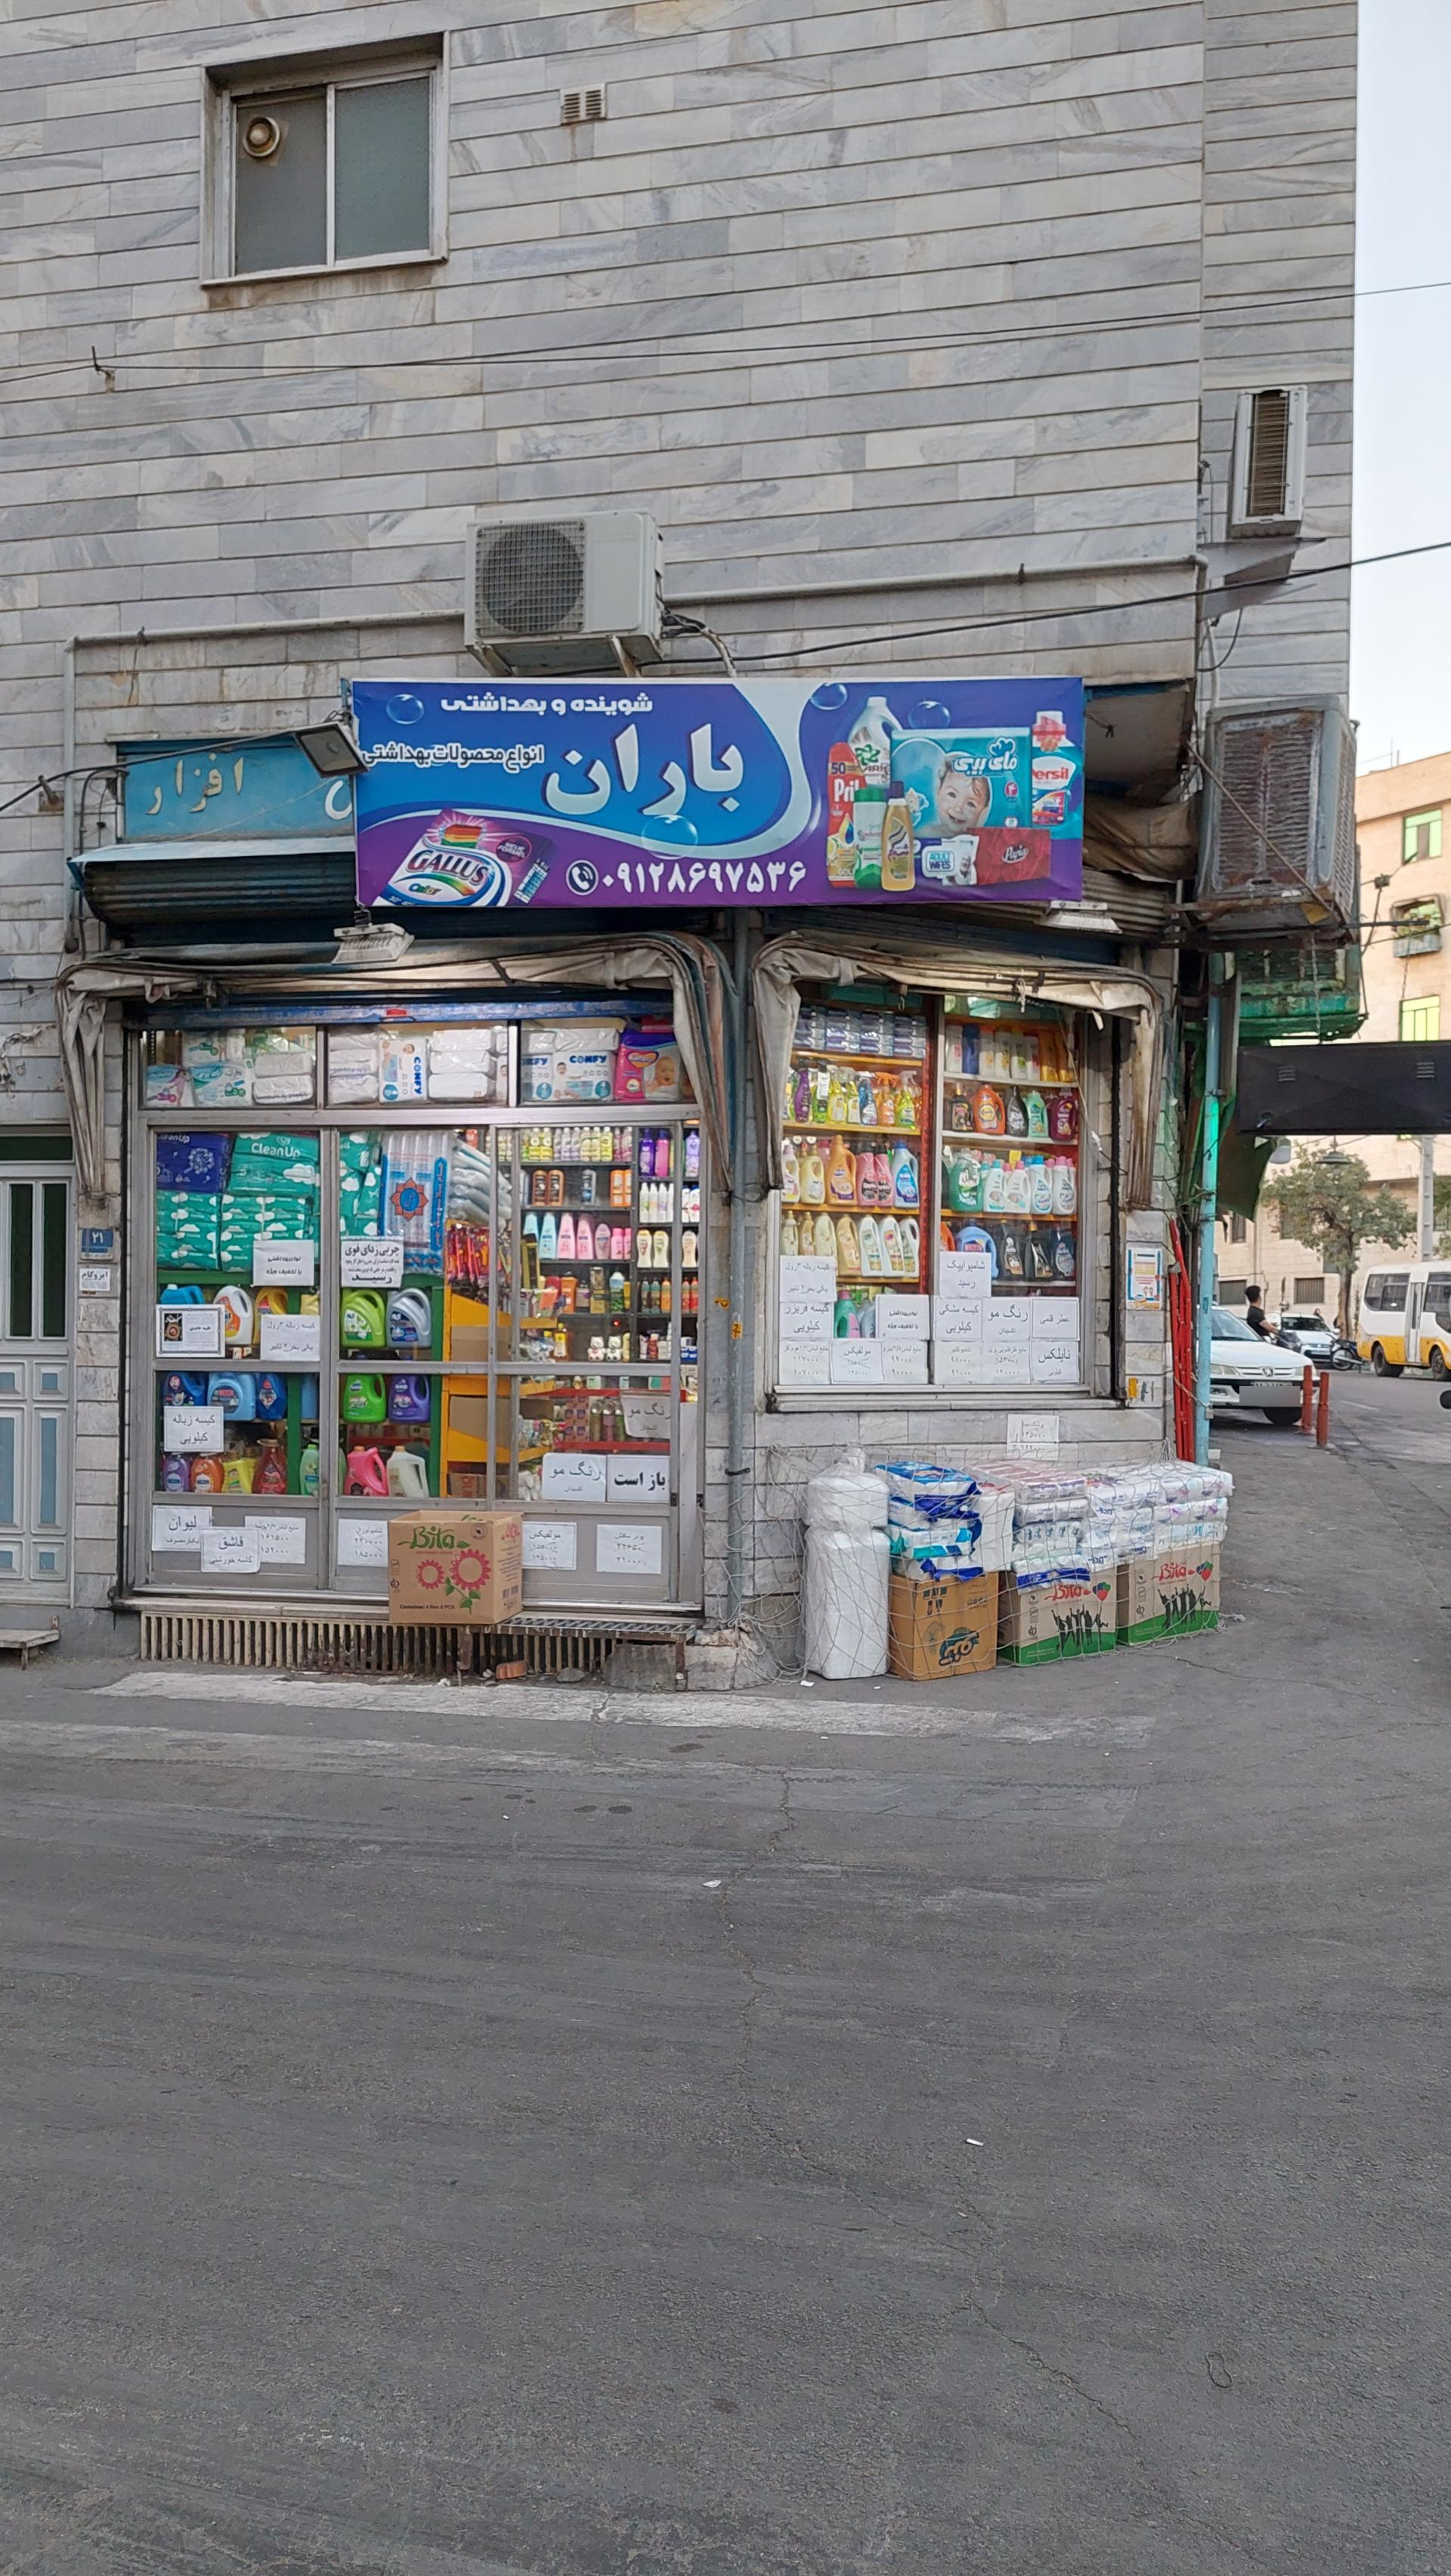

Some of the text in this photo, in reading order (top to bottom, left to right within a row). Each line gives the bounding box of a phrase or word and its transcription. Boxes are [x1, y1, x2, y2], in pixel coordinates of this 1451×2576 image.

[441, 691, 654, 716] شوینده و بهداشتی
[362, 742, 544, 773] انواع محصولات بهداشتی
[542, 722, 745, 815] باران
[831, 762, 846, 775] 50
[405, 849, 489, 886] GALLUS
[602, 859, 806, 894] ۰۹۱۲۸۶۹۷۵۳۶
[251, 1142, 302, 1158] CleanUp
[987, 1303, 1029, 1322] رنگ مو
[172, 1413, 216, 1427] کیسه زباله
[179, 1431, 209, 1445] کیلویی
[549, 1467, 565, 1479] مو
[613, 1471, 667, 1492] باز است
[168, 1515, 197, 1532] لیوان
[218, 1536, 244, 1550] قاشق
[398, 1525, 455, 1550] Bita
